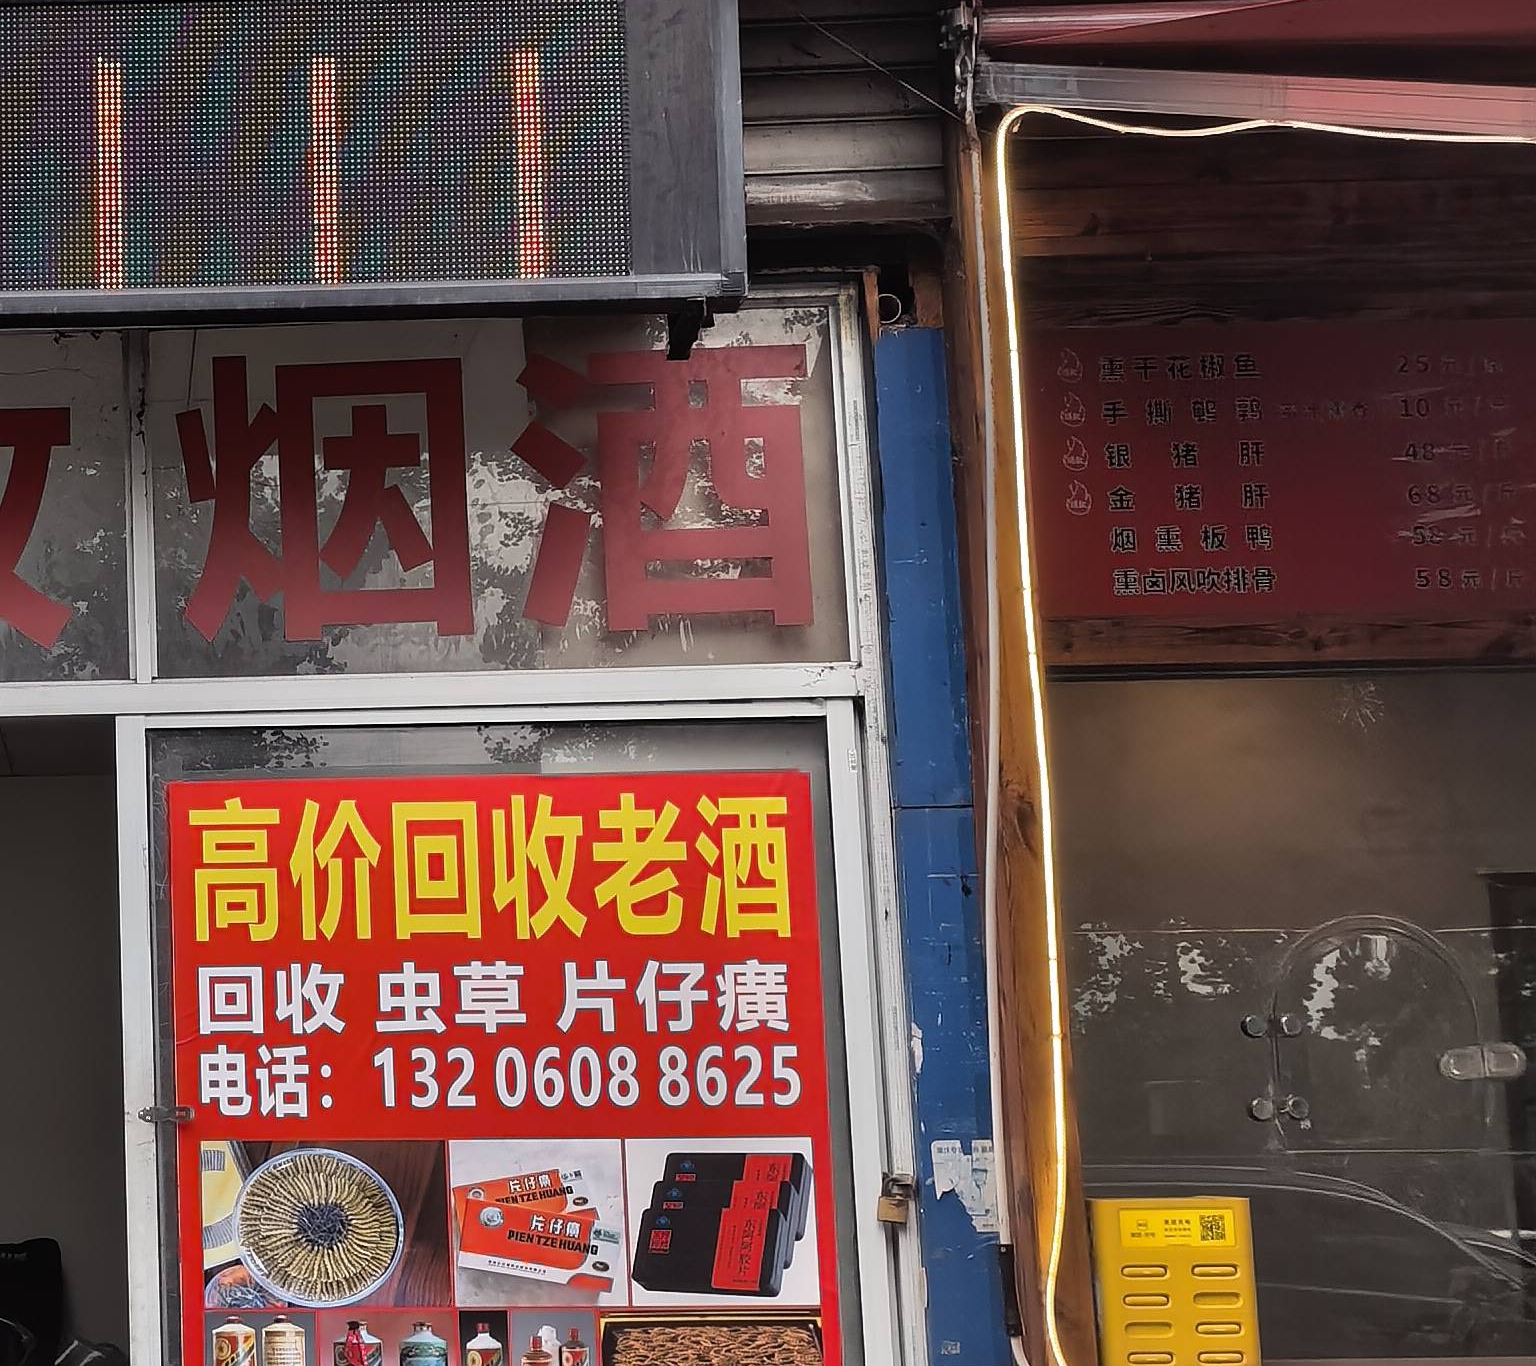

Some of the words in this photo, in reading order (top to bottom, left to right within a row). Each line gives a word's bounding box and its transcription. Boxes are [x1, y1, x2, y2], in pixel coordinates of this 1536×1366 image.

[1100, 354, 1262, 381] 熏干花椒鱼
[1104, 442, 1266, 468] 银猪肝
[1108, 484, 1270, 512] 金猪肝
[1110, 526, 1273, 553] 烟熏板鸭
[1114, 566, 1277, 596] 熏卤风吹排骨
[188, 792, 792, 942] 高价回收老酒
[197, 961, 346, 1035] 回收
[375, 960, 526, 1035] 虫草
[372, 1046, 477, 1108] 132
[495, 1045, 640, 1108] 0608
[658, 1044, 802, 1107] 8625
[559, 1237, 599, 1256] HUANG
